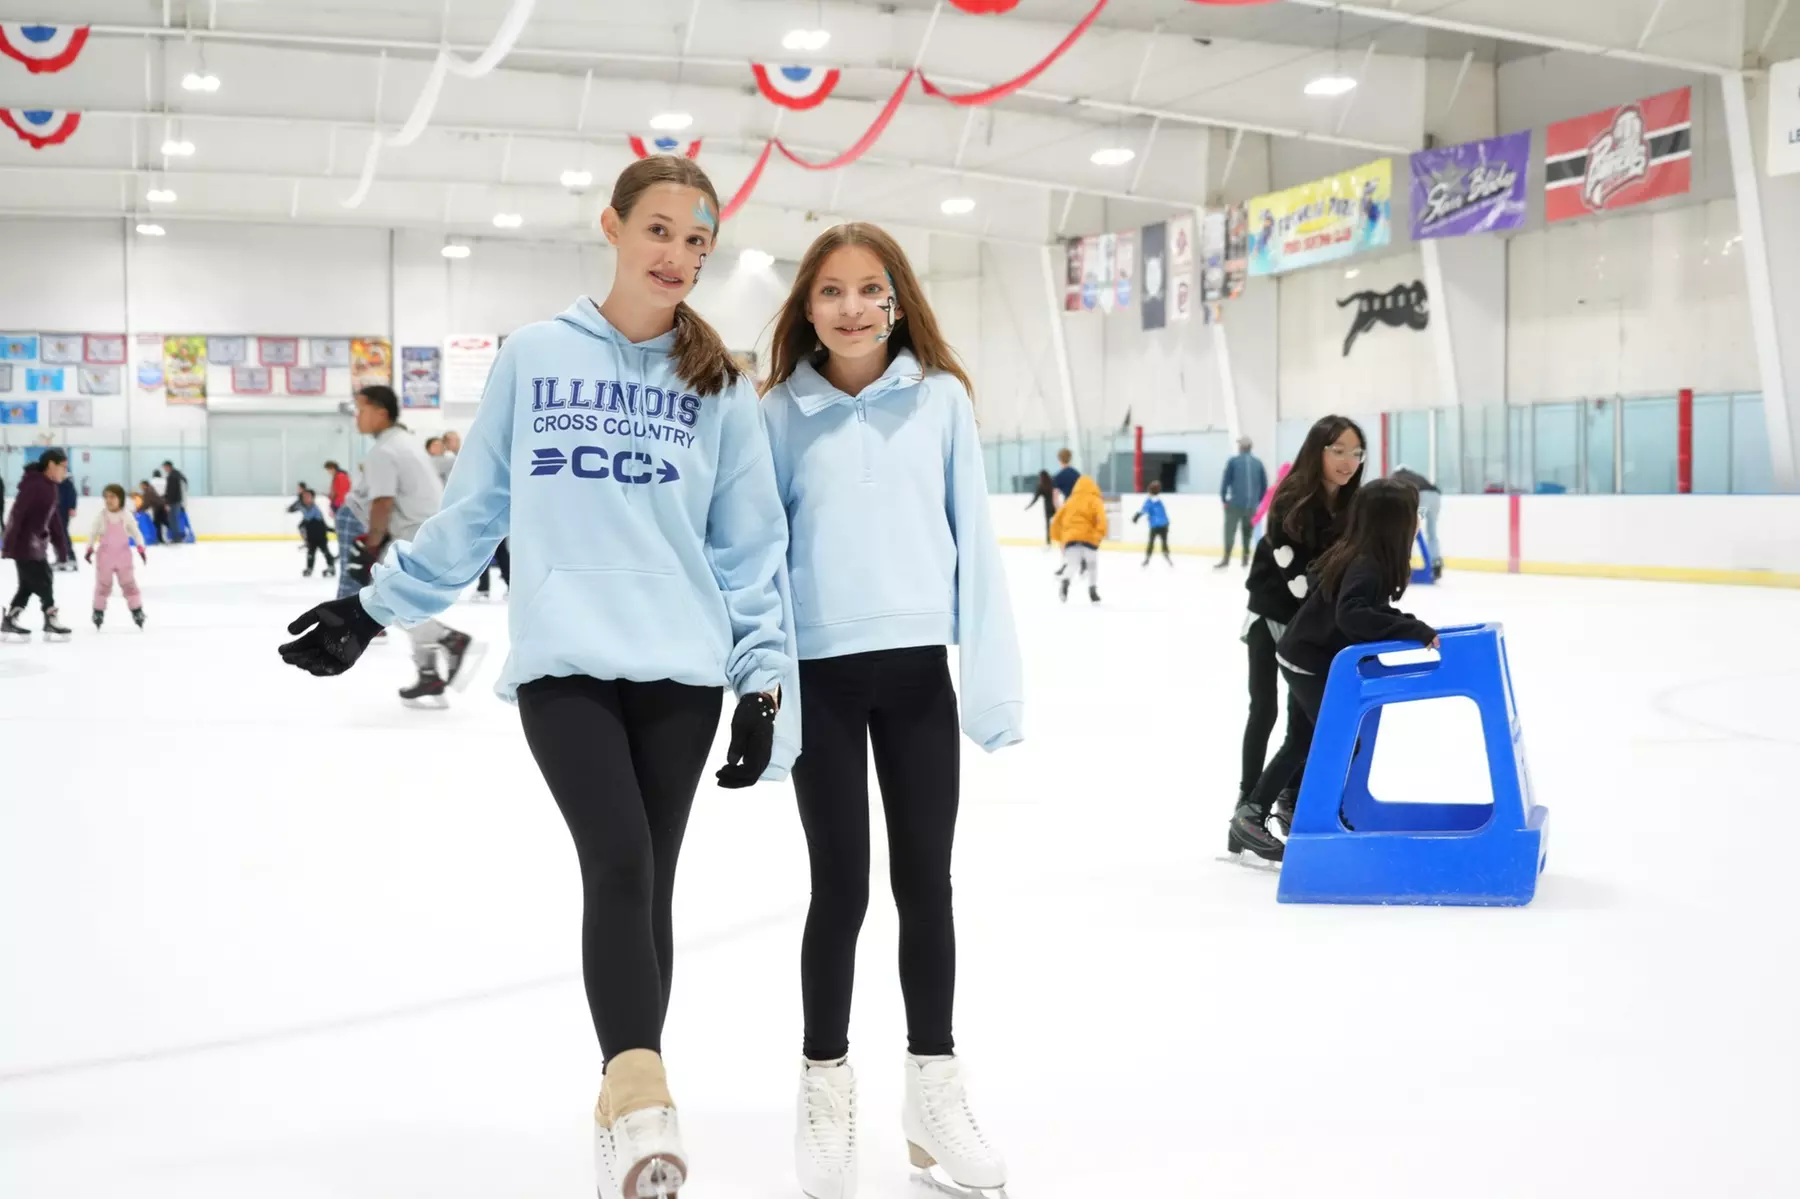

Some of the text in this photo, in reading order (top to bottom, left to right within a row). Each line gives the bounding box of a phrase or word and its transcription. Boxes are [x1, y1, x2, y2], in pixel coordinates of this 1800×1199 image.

[532, 376, 702, 428] ILLINOIS
[533, 414, 695, 449] CROSS COUNTRY
[571, 446, 652, 484] CC
